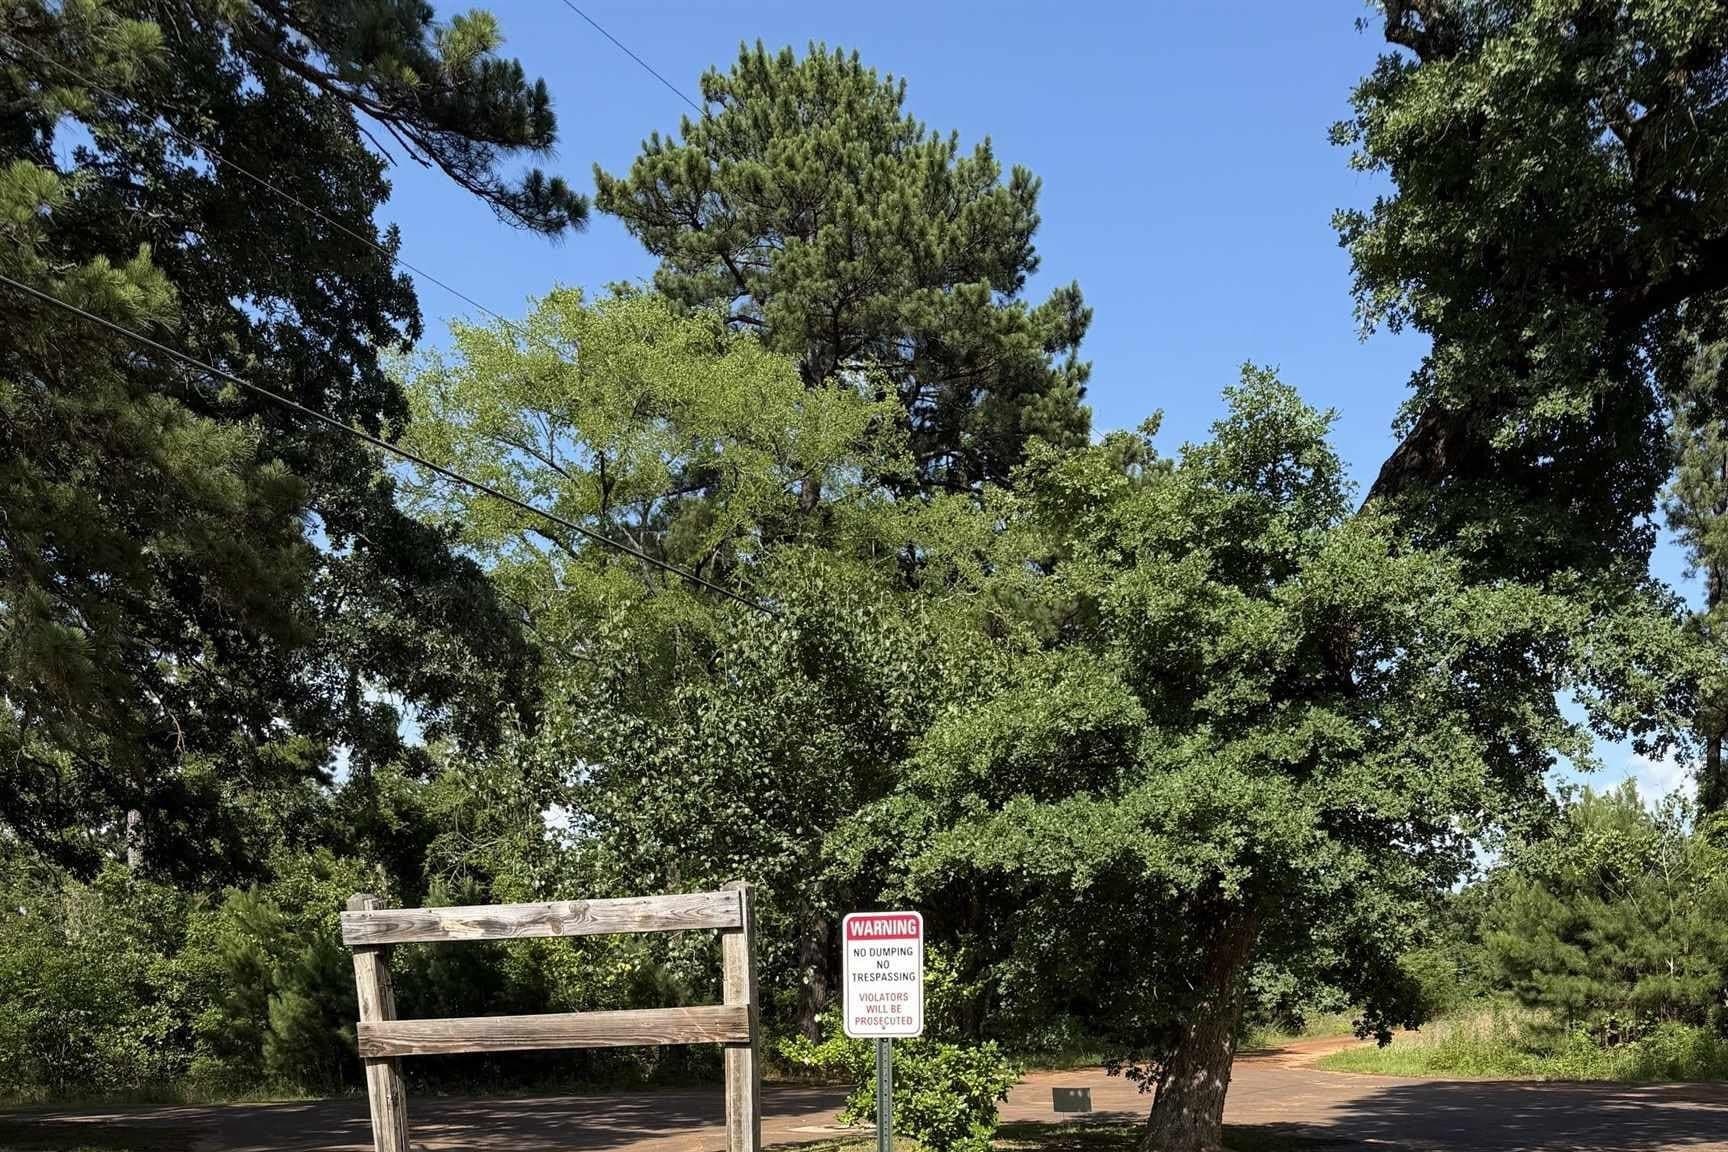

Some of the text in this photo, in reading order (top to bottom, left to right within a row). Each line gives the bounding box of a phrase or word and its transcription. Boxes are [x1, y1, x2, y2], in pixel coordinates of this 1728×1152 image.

[850, 919, 917, 936] WARNING
[853, 947, 913, 957] NO DUMPING
[876, 960, 890, 969] NO
[852, 972, 916, 982] TRESPASSING
[859, 992, 909, 1002] VIOLATORS
[866, 1004, 902, 1014] WILL BE
[855, 1016, 913, 1025] PROSECUTED
